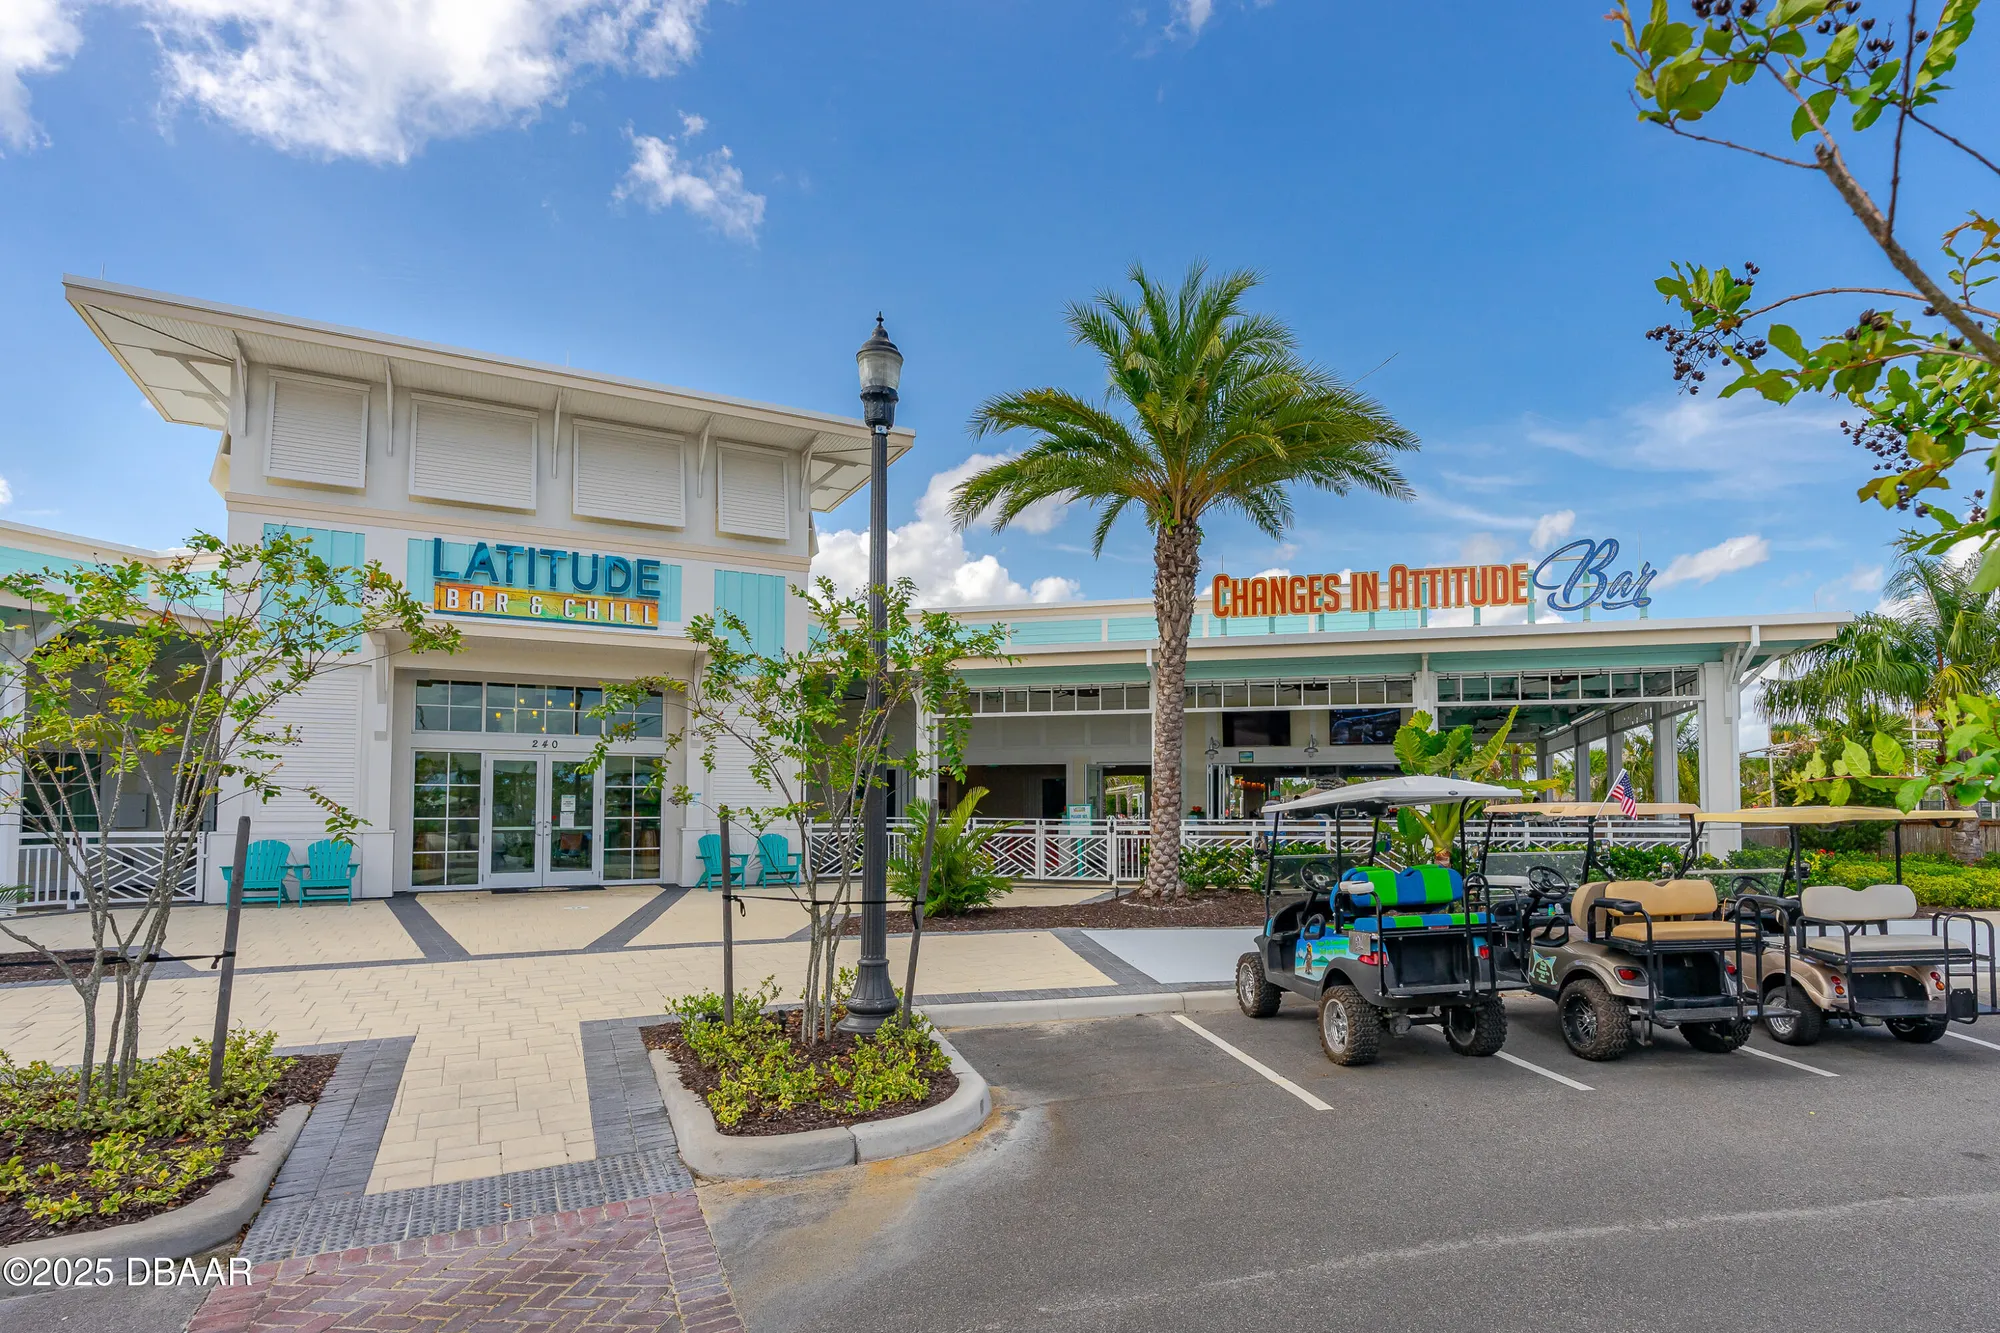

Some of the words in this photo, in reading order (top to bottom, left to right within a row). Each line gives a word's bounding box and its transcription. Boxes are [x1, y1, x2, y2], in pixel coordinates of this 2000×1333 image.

[433, 537, 661, 597] LATITUDE
[1212, 573, 1342, 618] CHANGES
[1350, 571, 1379, 613] IN
[1388, 563, 1529, 611] ATTITUDE
[1532, 538, 1658, 611] Bar
[446, 588, 509, 613] BAR
[530, 595, 543, 615] &
[563, 598, 653, 624] CHILL
[532, 739, 558, 749] 240
